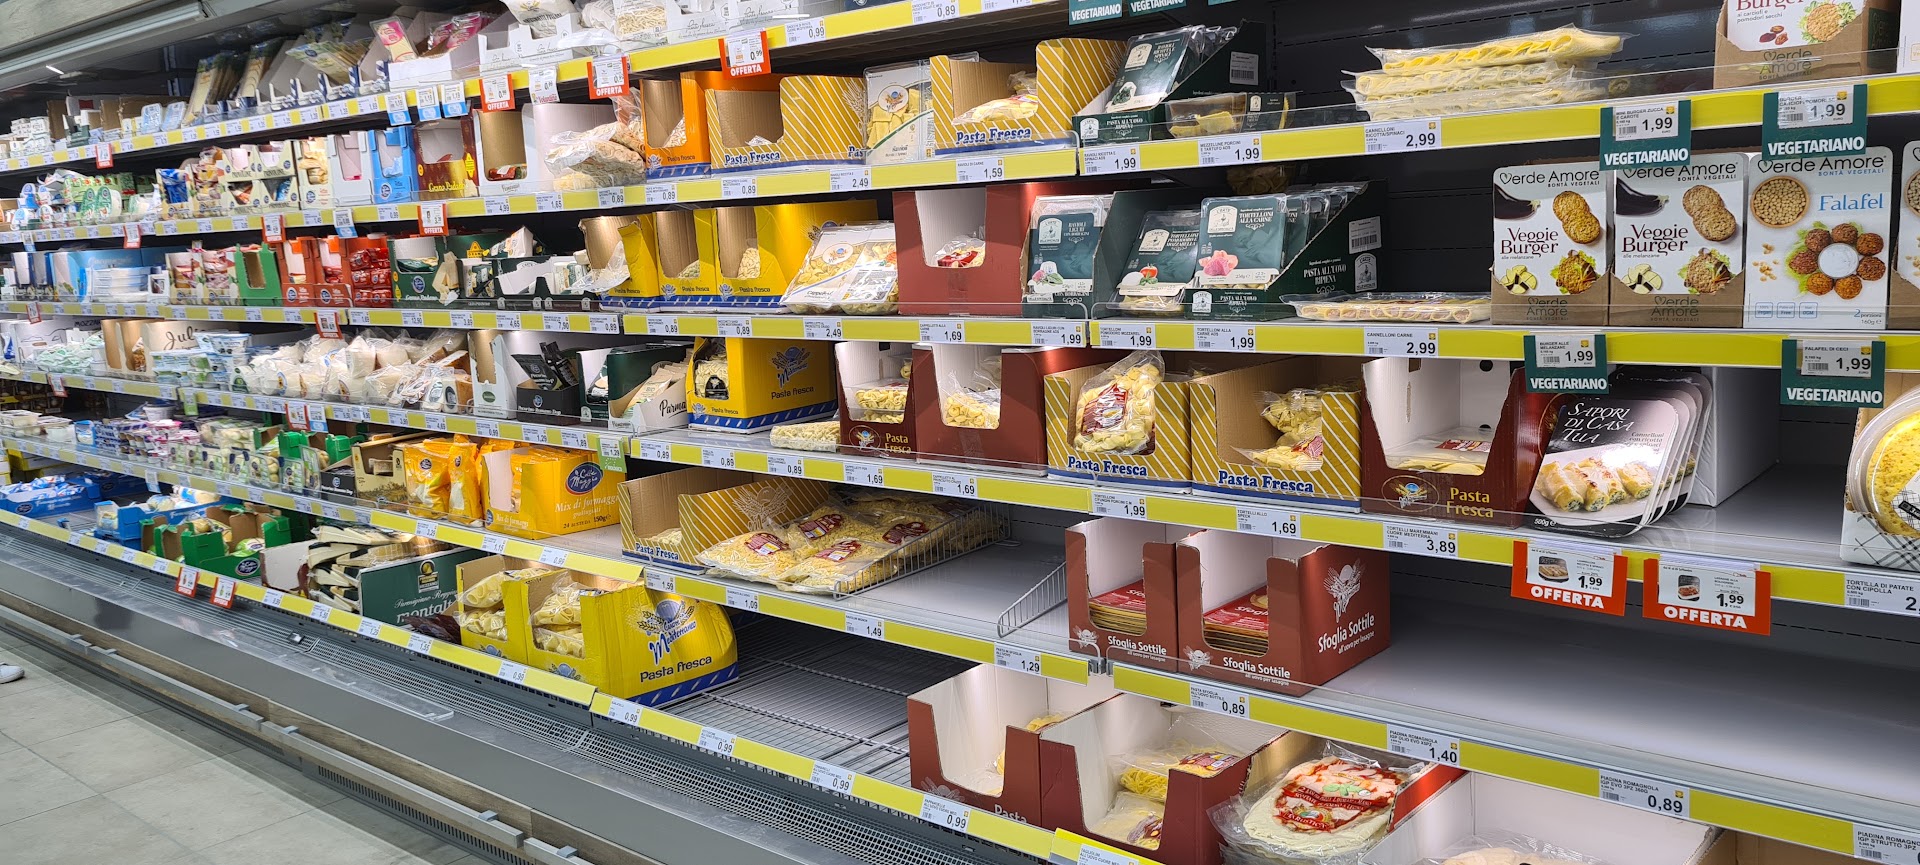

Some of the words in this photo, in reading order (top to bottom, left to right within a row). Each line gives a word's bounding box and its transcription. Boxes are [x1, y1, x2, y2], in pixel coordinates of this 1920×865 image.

[938, 6, 956, 18] 0,89
[1072, 4, 1122, 22] VEGETARIANO
[808, 27, 825, 39] 0,99
[750, 50, 762, 60] 0,99
[730, 64, 762, 77] OFFERTA
[1760, 61, 1812, 74] Amore
[596, 86, 622, 97] OFFERTA
[488, 101, 510, 112] OFFERTA
[1811, 104, 1846, 120] 1,99
[1642, 116, 1673, 134] 1,99
[956, 130, 986, 145] Pasta
[988, 126, 1032, 143] Fresca
[1406, 133, 1436, 148] 2,99
[1768, 137, 1865, 156] VEGETARIANO
[725, 154, 748, 167] Pasta
[750, 152, 780, 164] Fresca
[1234, 148, 1260, 162] 1,99
[1604, 148, 1689, 166] VEGETARIANO
[1114, 158, 1136, 170] 1,99
[1758, 157, 1816, 174] Verde
[1819, 154, 1884, 171] Amore
[984, 168, 1003, 181] 1,59
[1500, 172, 1545, 185] Verde
[1548, 170, 1600, 182] Amore
[1622, 166, 1678, 180] Verde
[1679, 162, 1736, 176] Amore
[742, 185, 756, 195] 0,89
[852, 178, 869, 190] 2,49
[612, 195, 624, 204] 0,89
[662, 192, 676, 201] 0,89
[1818, 194, 1884, 211] Falafel
[499, 204, 510, 214] 4,99
[552, 201, 562, 210] 1,65
[424, 227, 444, 236] OFFERTA
[1508, 228, 1558, 244] Veggie
[1631, 225, 1688, 242] Veggie
[1501, 240, 1558, 258] Burger
[1622, 238, 1689, 256] Burger
[1304, 268, 1320, 277] PASTA
[1527, 306, 1568, 317] Amore
[1651, 306, 1699, 317] Amore
[510, 320, 520, 328] 4,65
[604, 324, 617, 332] 0,89
[666, 324, 678, 334] 0,89
[736, 326, 750, 336] 0,89
[826, 328, 842, 338] 2,49
[944, 335, 962, 346] 1,69
[1061, 334, 1081, 345] 1,99
[1130, 336, 1152, 347] 1,99
[1230, 336, 1254, 349] 1,99
[1406, 342, 1436, 356] 2,99
[1565, 350, 1594, 364] 1,99
[1836, 358, 1870, 371] 1,99
[1530, 378, 1608, 392] VEGETARIANO
[771, 390, 791, 400] Pasta
[792, 386, 814, 397] fresca
[1787, 388, 1882, 404] VEGETARIANO
[1568, 403, 1631, 421] SAPORI
[1564, 418, 1582, 428] DI
[1587, 417, 1634, 432] CASA
[536, 434, 547, 443] 1,29
[885, 432, 908, 444] Pasta
[1562, 428, 1600, 444] TUA
[576, 438, 588, 448] 1,89
[884, 442, 912, 456] Fresca
[610, 448, 620, 457] 1,29
[657, 450, 670, 460] 0,89
[720, 458, 734, 468] 0,89
[788, 464, 802, 475] 0,89
[1068, 456, 1100, 473] Pasta
[1104, 461, 1148, 477] Fresca
[867, 474, 883, 484] 1,69
[1218, 470, 1259, 489] Pasta
[1262, 475, 1314, 494] Fresca
[958, 484, 975, 496] 1,69
[1450, 488, 1490, 503] Pasta
[555, 502, 571, 514] Mix
[572, 500, 582, 512] di
[1124, 504, 1146, 518] 1,99
[1446, 501, 1494, 518] Fresca
[496, 514, 506, 524] Mix
[511, 517, 530, 530] formaggi
[594, 514, 607, 524] 150g
[1534, 518, 1550, 527] 500g
[1272, 521, 1296, 534] 1,69
[494, 543, 504, 552] 1,15
[636, 542, 654, 556] Pasta
[656, 546, 678, 562] Fresca
[1426, 539, 1456, 554] 3,89
[554, 556, 564, 566] 0,99
[662, 580, 674, 591] 1,59
[1578, 576, 1602, 589] 1,99
[1847, 580, 1879, 588] TORTILLA
[1530, 586, 1604, 609] OFFERTA
[1864, 587, 1892, 595] CIPOLLA
[394, 596, 432, 608] Parmigiano
[745, 598, 758, 609] 1,09
[1716, 594, 1744, 608] 1,99
[1664, 605, 1747, 629] OFFERTA
[867, 626, 882, 638] 1,49
[1318, 627, 1346, 654] Sfoglia
[1348, 612, 1376, 634] Sottile
[1108, 636, 1136, 651] Sfoglia
[1138, 640, 1167, 656] Sottile
[640, 666, 674, 684] Pasta
[677, 656, 712, 673] fresca
[1022, 660, 1040, 673] 1,29
[1223, 657, 1256, 675] Sfoglia
[1258, 663, 1290, 680] Sottile
[512, 671, 525, 682] 0,99
[1222, 701, 1246, 716] 0,89
[624, 711, 638, 723] 0,99
[1390, 731, 1408, 739] PIADINA
[1409, 734, 1438, 745] ROMAGNOLA
[718, 741, 734, 754] 0,99
[1430, 747, 1458, 764] 1,40
[833, 778, 850, 792] 0,99
[1600, 776, 1622, 784] PIADINA
[1623, 779, 1660, 792] ROMAGNOLA
[1648, 795, 1683, 814] 0,89
[946, 814, 966, 829] 0,99
[1858, 831, 1881, 840] PIADINA
[1871, 838, 1902, 850] STRUTTO
[1903, 846, 1918, 857] 3PZ
